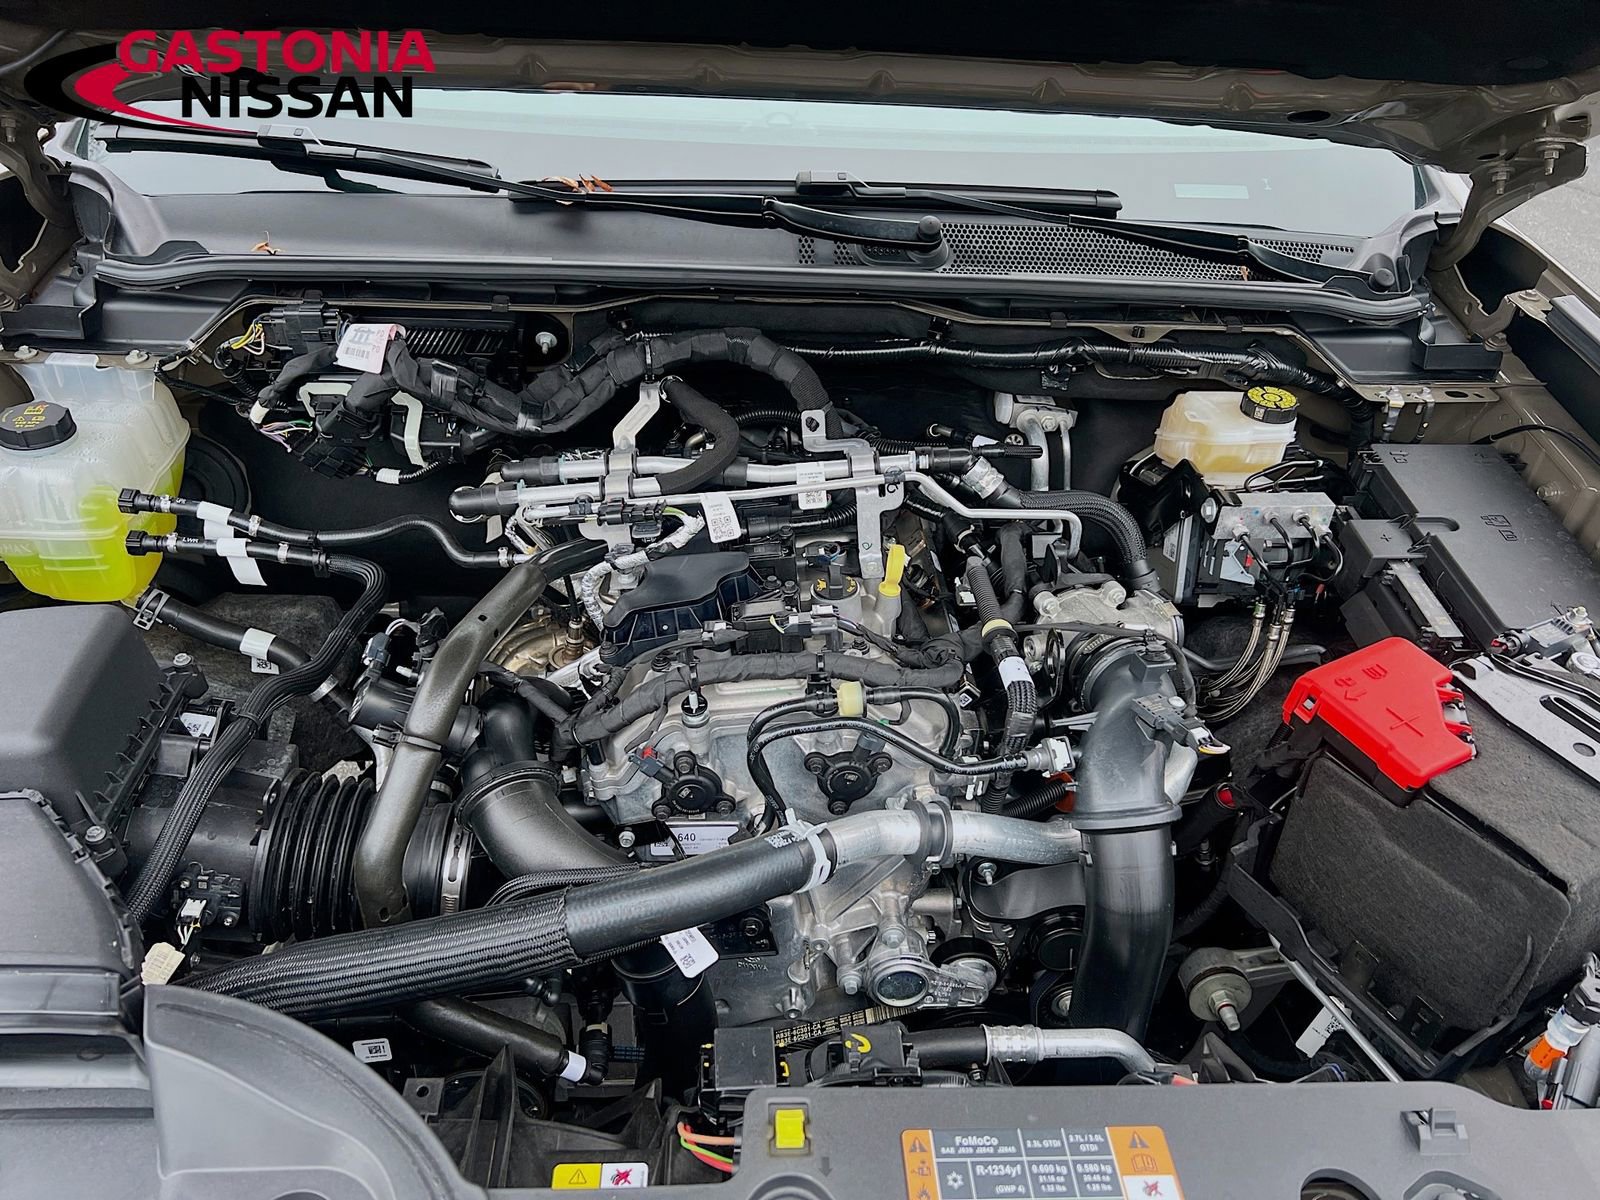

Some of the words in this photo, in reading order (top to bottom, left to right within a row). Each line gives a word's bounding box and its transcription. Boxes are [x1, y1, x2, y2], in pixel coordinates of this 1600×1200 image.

[677, 833, 696, 842] 640
[955, 1136, 999, 1146] FoMoCo
[976, 1164, 1022, 1178] R-1234yf
[1031, 1164, 1054, 1174] 0.600
[1056, 1164, 1068, 1175] kg
[1101, 1163, 1113, 1175] kg
